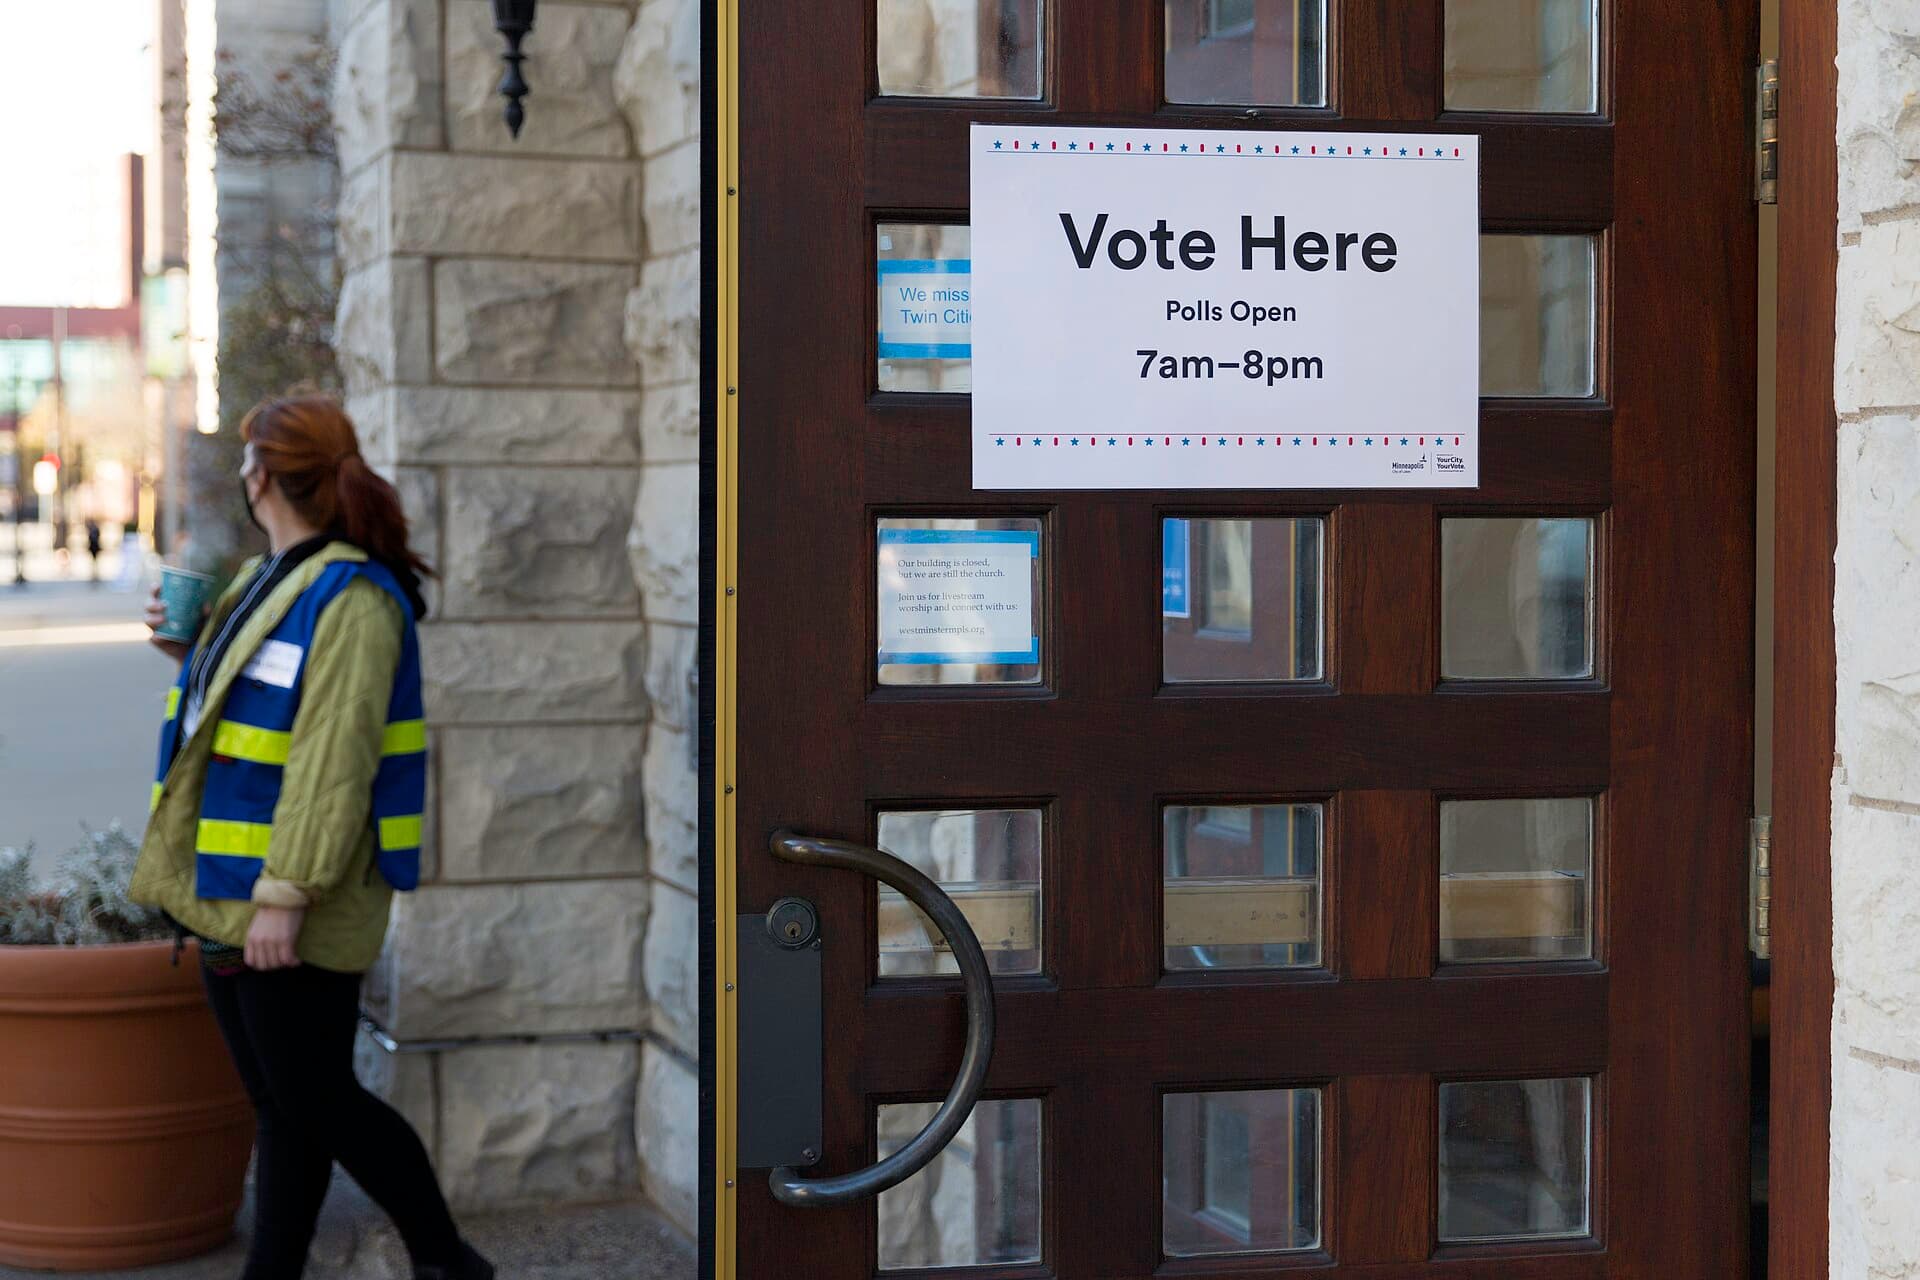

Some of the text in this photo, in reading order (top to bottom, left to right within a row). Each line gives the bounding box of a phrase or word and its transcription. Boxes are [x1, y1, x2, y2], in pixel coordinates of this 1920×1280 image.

[1059, 212, 1397, 272] Vote Here
[900, 287, 969, 302] We miss
[900, 308, 972, 324] Twin Citi
[1166, 300, 1297, 327] Polls Open
[1392, 462, 1424, 470] Minneapolis
[898, 558, 990, 569] Our building is closed,
[899, 570, 912, 579] but
[943, 569, 958, 578] still
[960, 569, 973, 578] the
[975, 569, 1005, 577] church.
[898, 592, 915, 602] Join
[928, 592, 940, 601] for
[942, 592, 985, 601] livestream
[899, 603, 932, 614] worship
[934, 603, 949, 611] and
[985, 602, 1004, 610] with
[900, 625, 985, 635] westminstermpls.org
